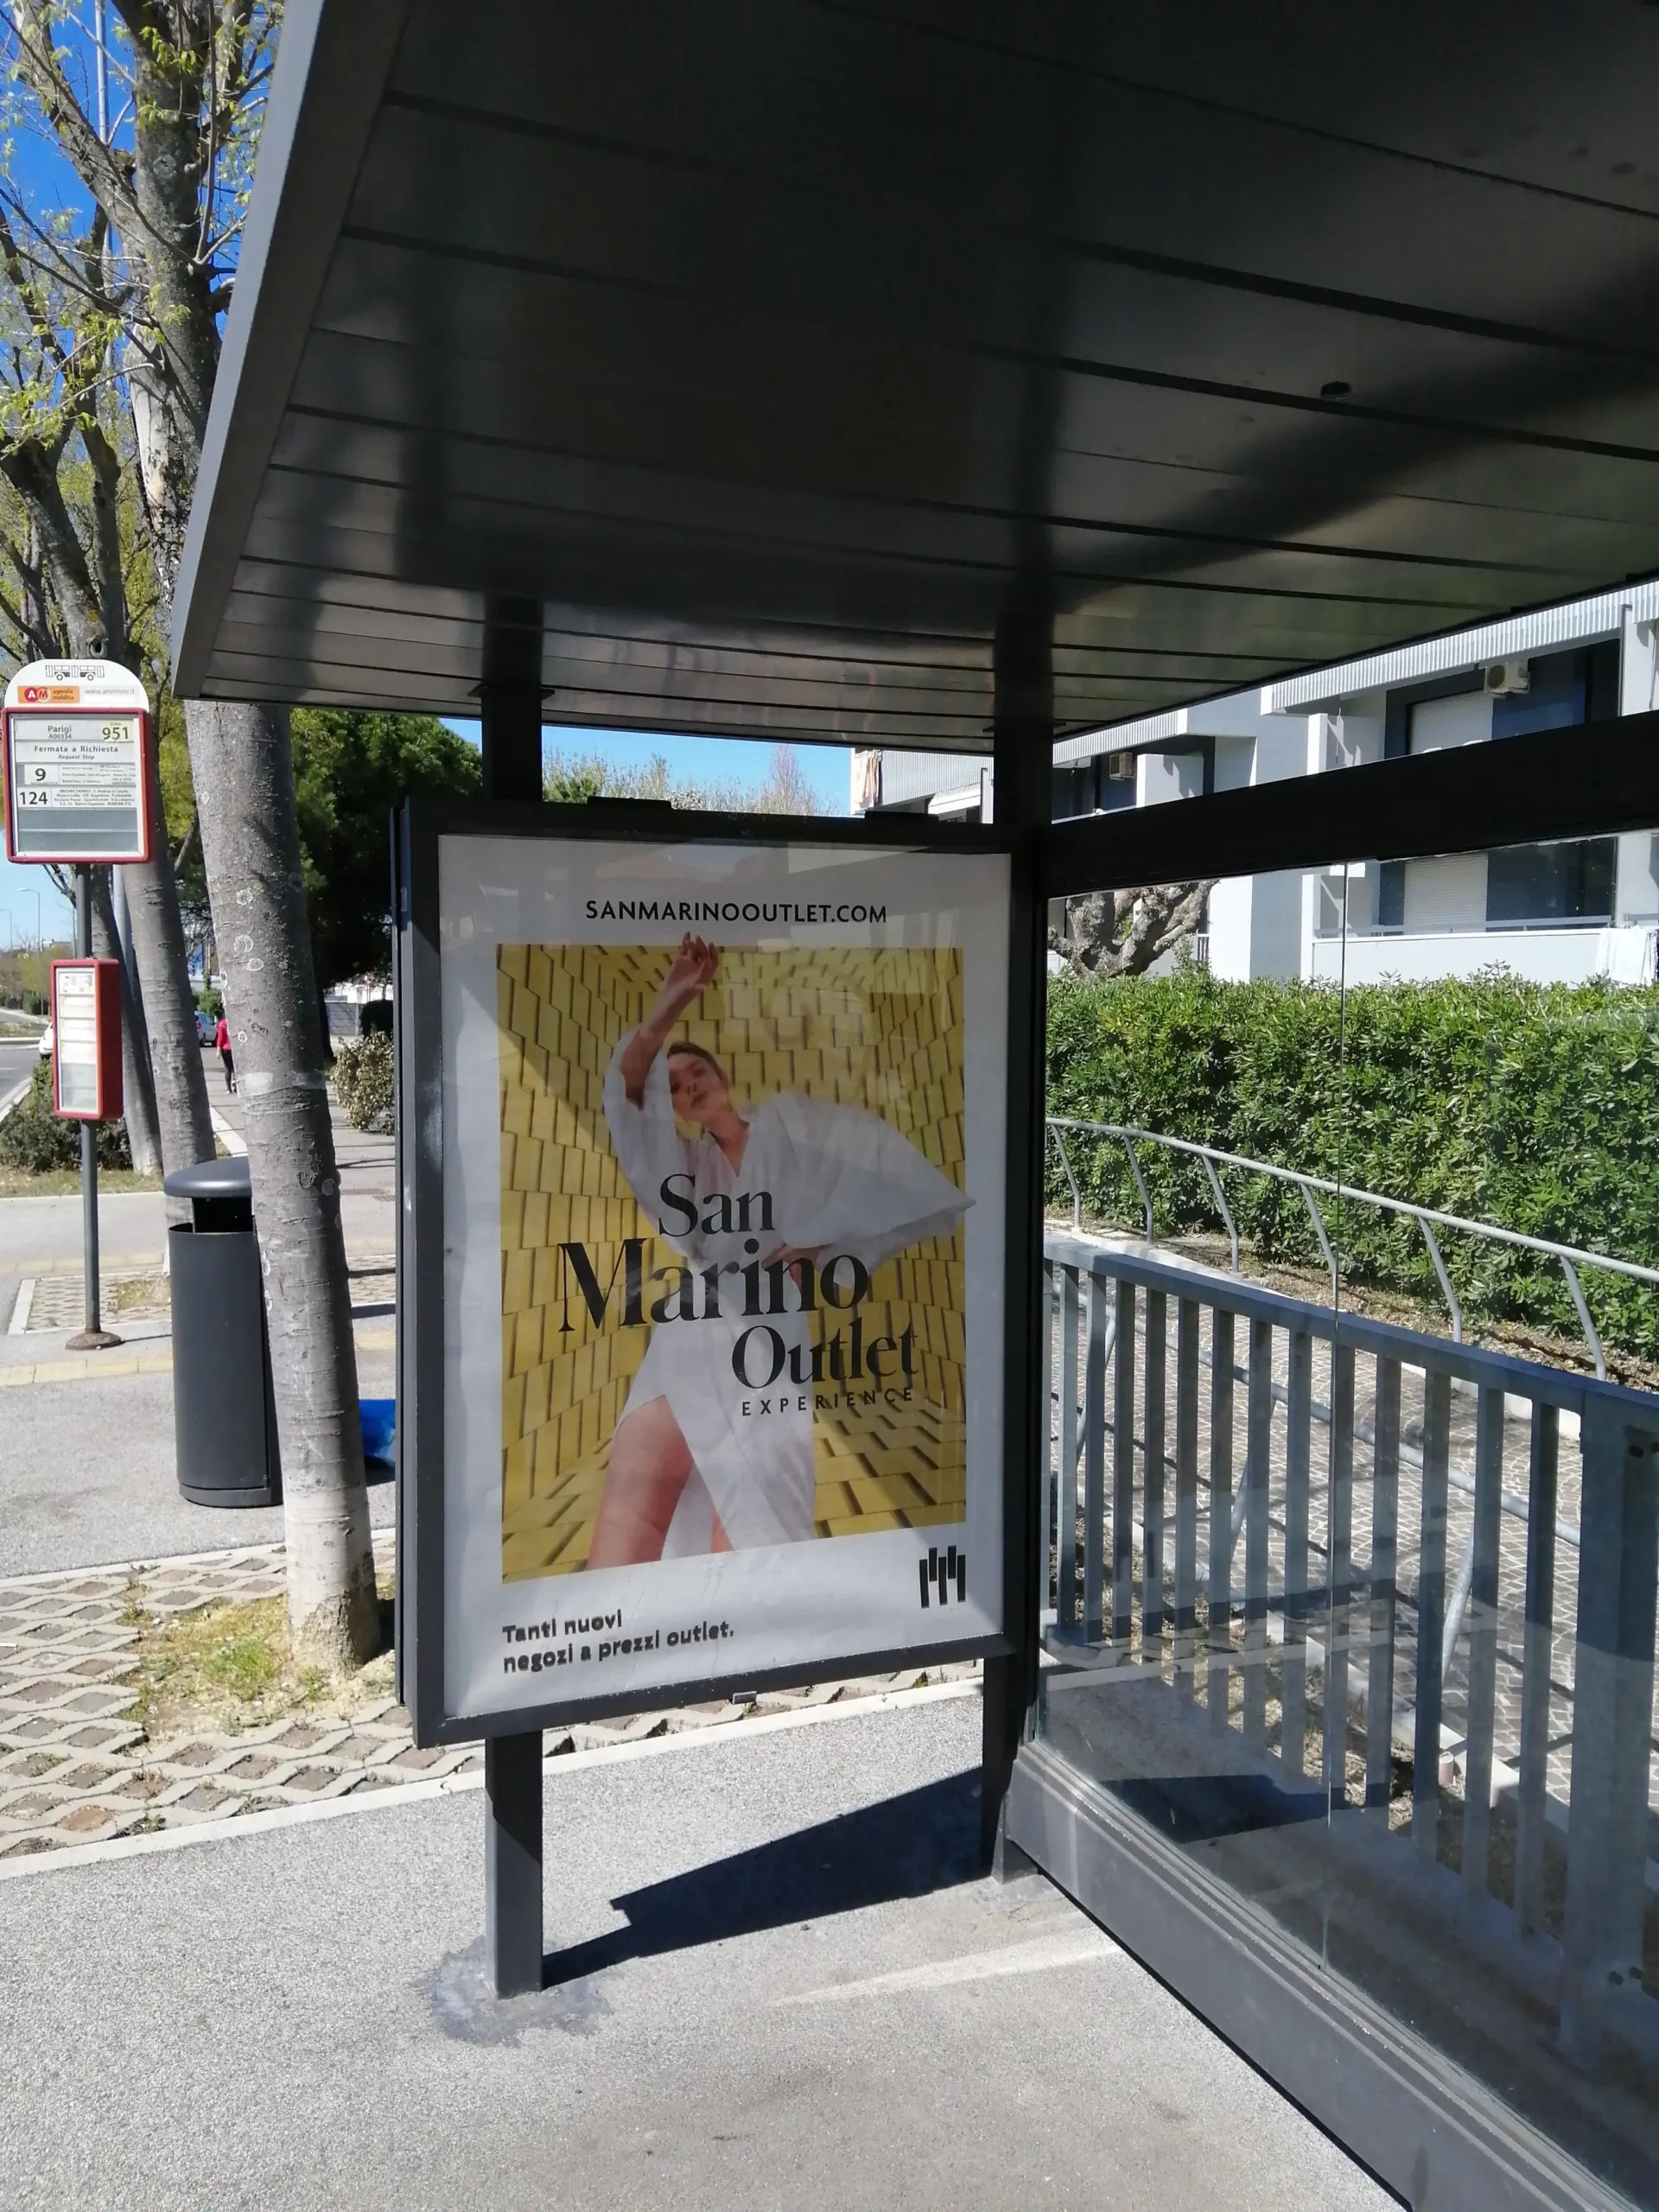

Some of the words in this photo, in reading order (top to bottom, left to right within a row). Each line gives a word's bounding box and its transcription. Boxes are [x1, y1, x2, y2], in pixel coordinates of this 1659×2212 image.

[48, 725, 72, 734] Parigi
[102, 727, 129, 740] 951
[35, 767, 46, 781] 9
[19, 791, 48, 804] 124
[586, 899, 887, 923] SANMARINOOUTLET.COM
[658, 1173, 775, 1237] San
[557, 1238, 868, 1332] Marino
[732, 1316, 920, 1389] Outlet
[741, 1387, 913, 1417] EXPERIENCE
[502, 1618, 557, 1643] Tanti
[564, 1608, 622, 1636] nuovi
[504, 1643, 574, 1674] negozi
[581, 1645, 592, 1661] a
[599, 1630, 660, 1662] prezzi
[666, 1620, 734, 1647] outlet.
